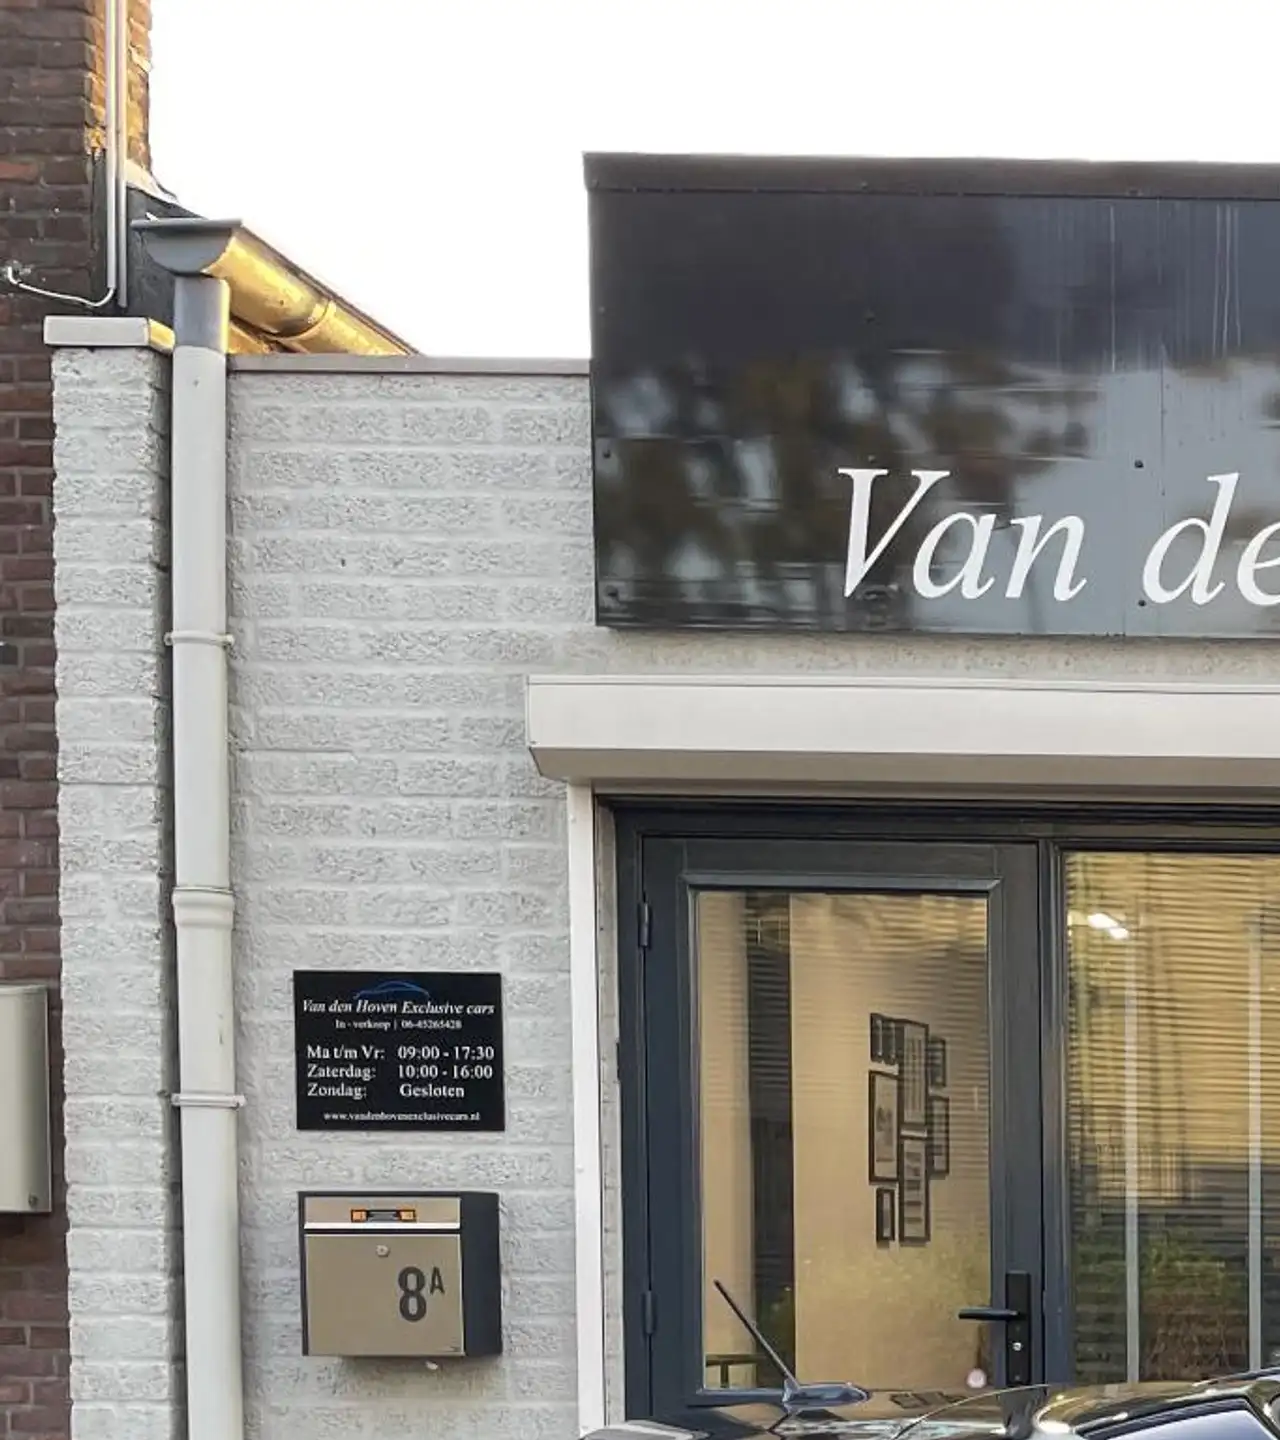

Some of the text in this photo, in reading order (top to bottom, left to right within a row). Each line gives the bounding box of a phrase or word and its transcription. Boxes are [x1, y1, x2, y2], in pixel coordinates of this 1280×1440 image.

[838, 468, 1087, 602] Van
[302, 999, 495, 1015] Van den Hoven Exclusive cars
[307, 1045, 332, 1060] Ma
[333, 1045, 358, 1060] t/m
[361, 1045, 386, 1060] Vr:
[398, 1046, 440, 1060] 09:00
[454, 1046, 495, 1061] 17:30
[307, 1063, 377, 1081] Zaterdag:
[399, 1064, 439, 1079] 10:00
[453, 1065, 493, 1080] 16:00
[307, 1082, 465, 1100] Zondag: Gesloten
